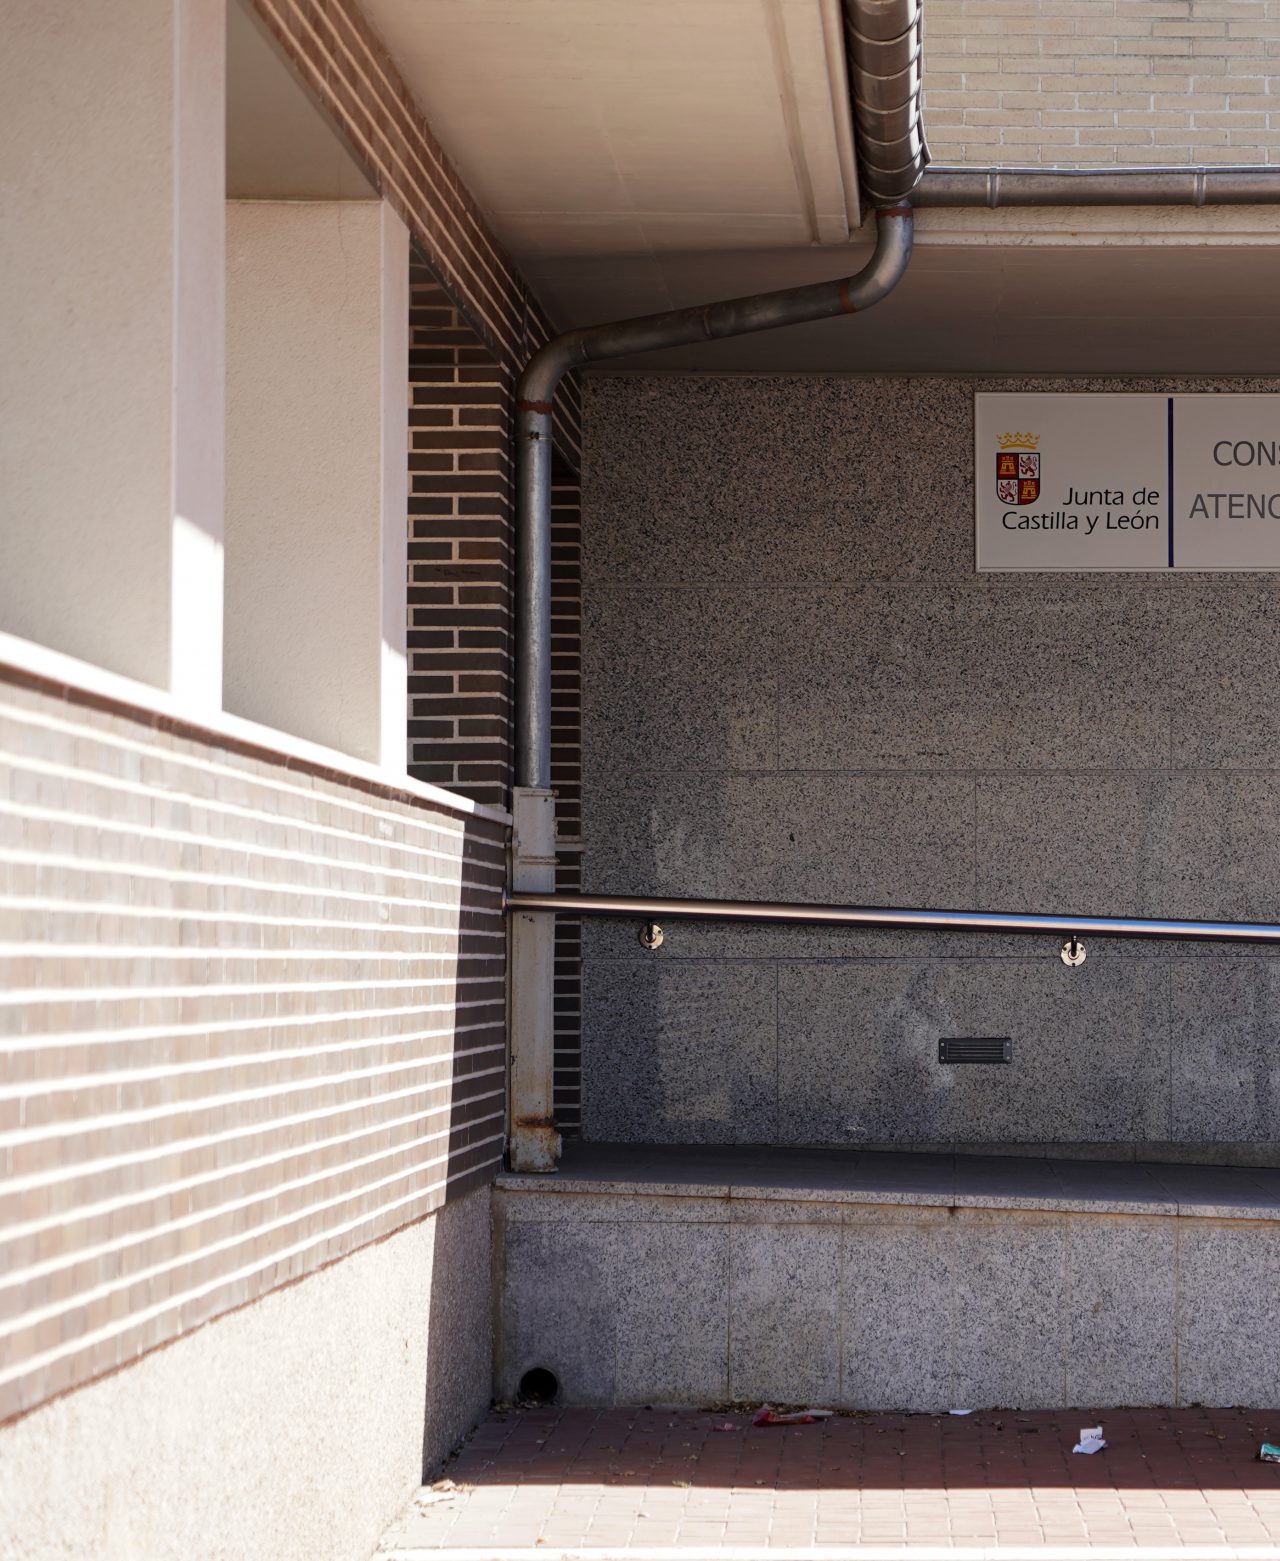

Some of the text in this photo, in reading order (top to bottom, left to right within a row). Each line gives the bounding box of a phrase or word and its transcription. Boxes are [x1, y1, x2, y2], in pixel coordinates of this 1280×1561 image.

[1062, 487, 1160, 506] Junta de
[1002, 508, 1159, 536] Castilla y León
